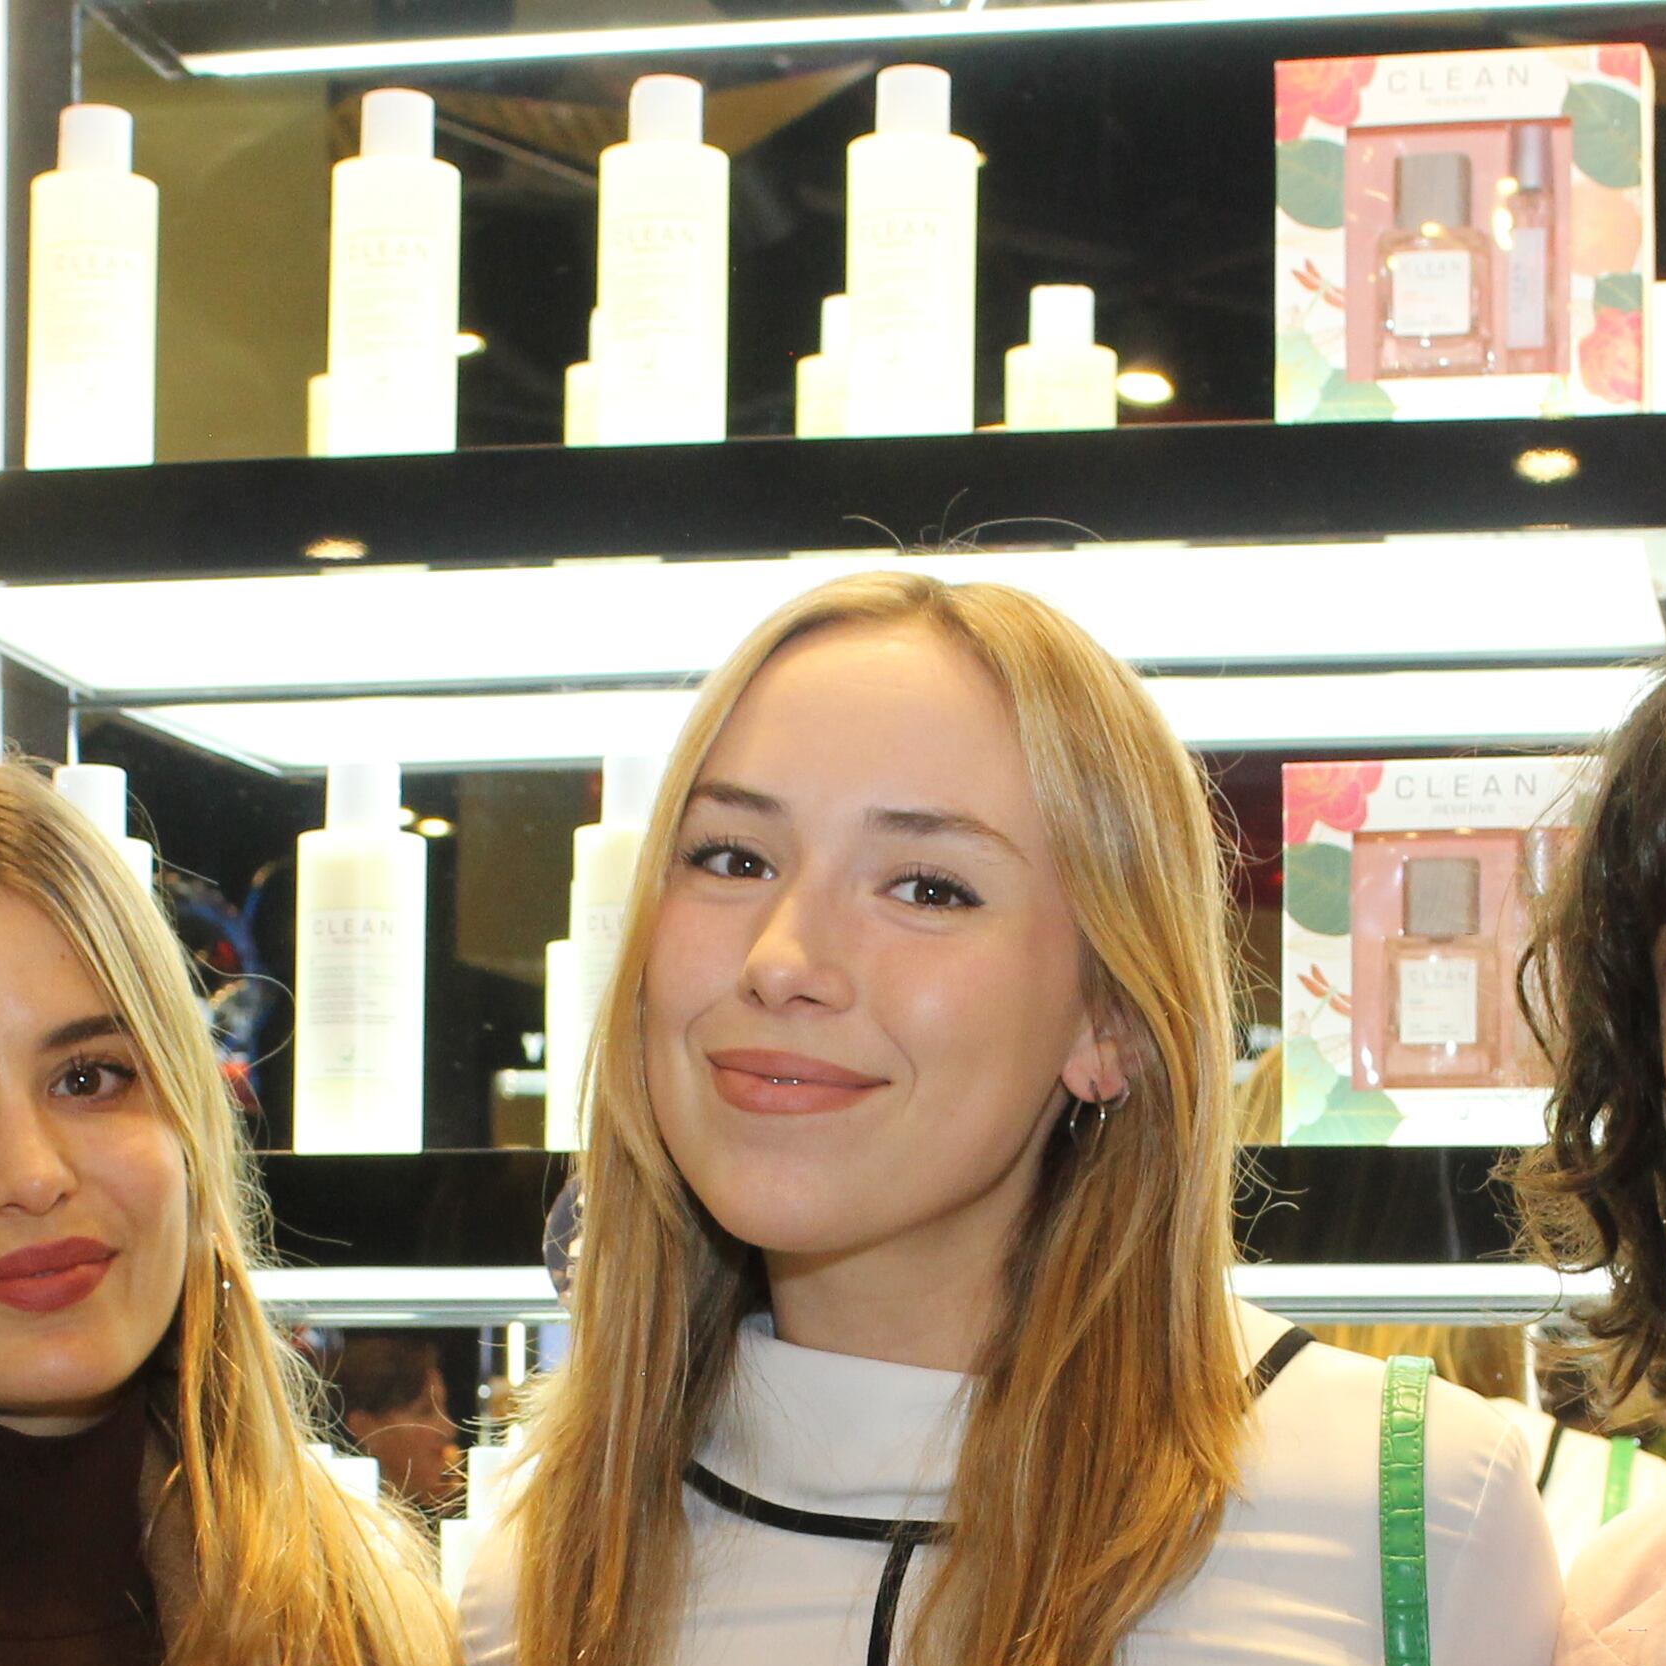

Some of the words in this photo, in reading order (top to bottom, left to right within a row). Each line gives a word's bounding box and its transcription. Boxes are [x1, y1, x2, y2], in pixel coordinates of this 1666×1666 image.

[1387, 64, 1529, 93] CLEAN
[1395, 774, 1537, 799] CLEAN
[312, 918, 394, 936] CLEAN
